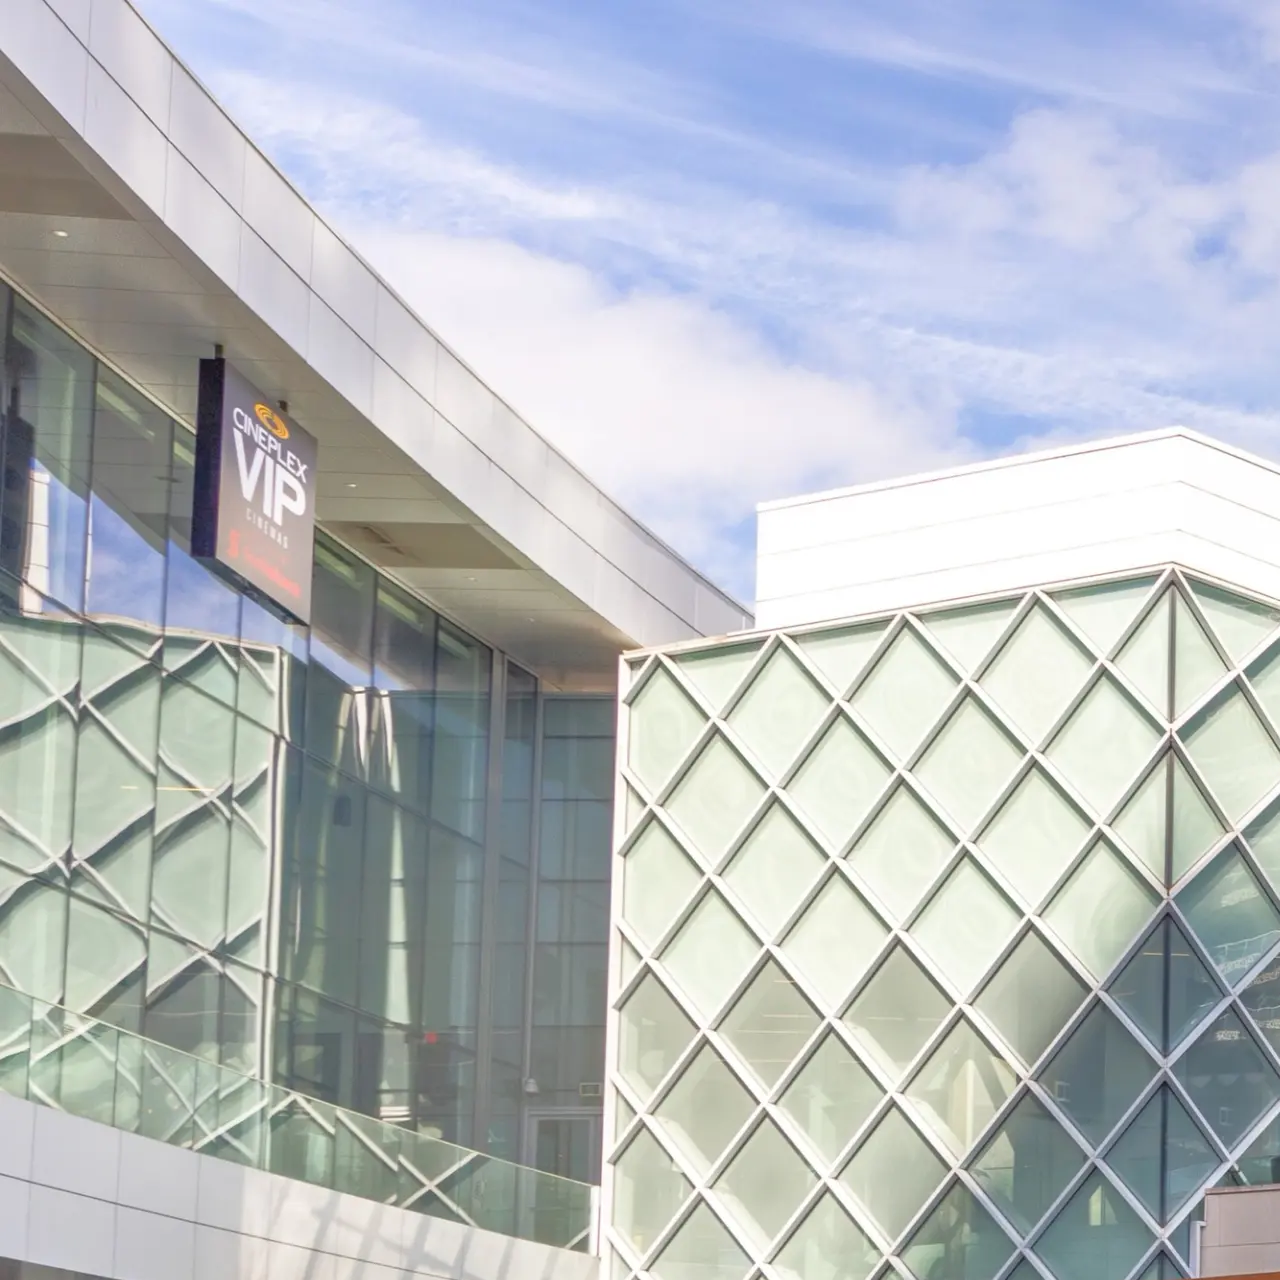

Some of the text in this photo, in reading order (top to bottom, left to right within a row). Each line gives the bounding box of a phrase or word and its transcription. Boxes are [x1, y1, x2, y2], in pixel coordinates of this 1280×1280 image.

[232, 406, 308, 484] CINEPLEX
[232, 427, 307, 527] VIP
[246, 507, 290, 550] CINEMAS
